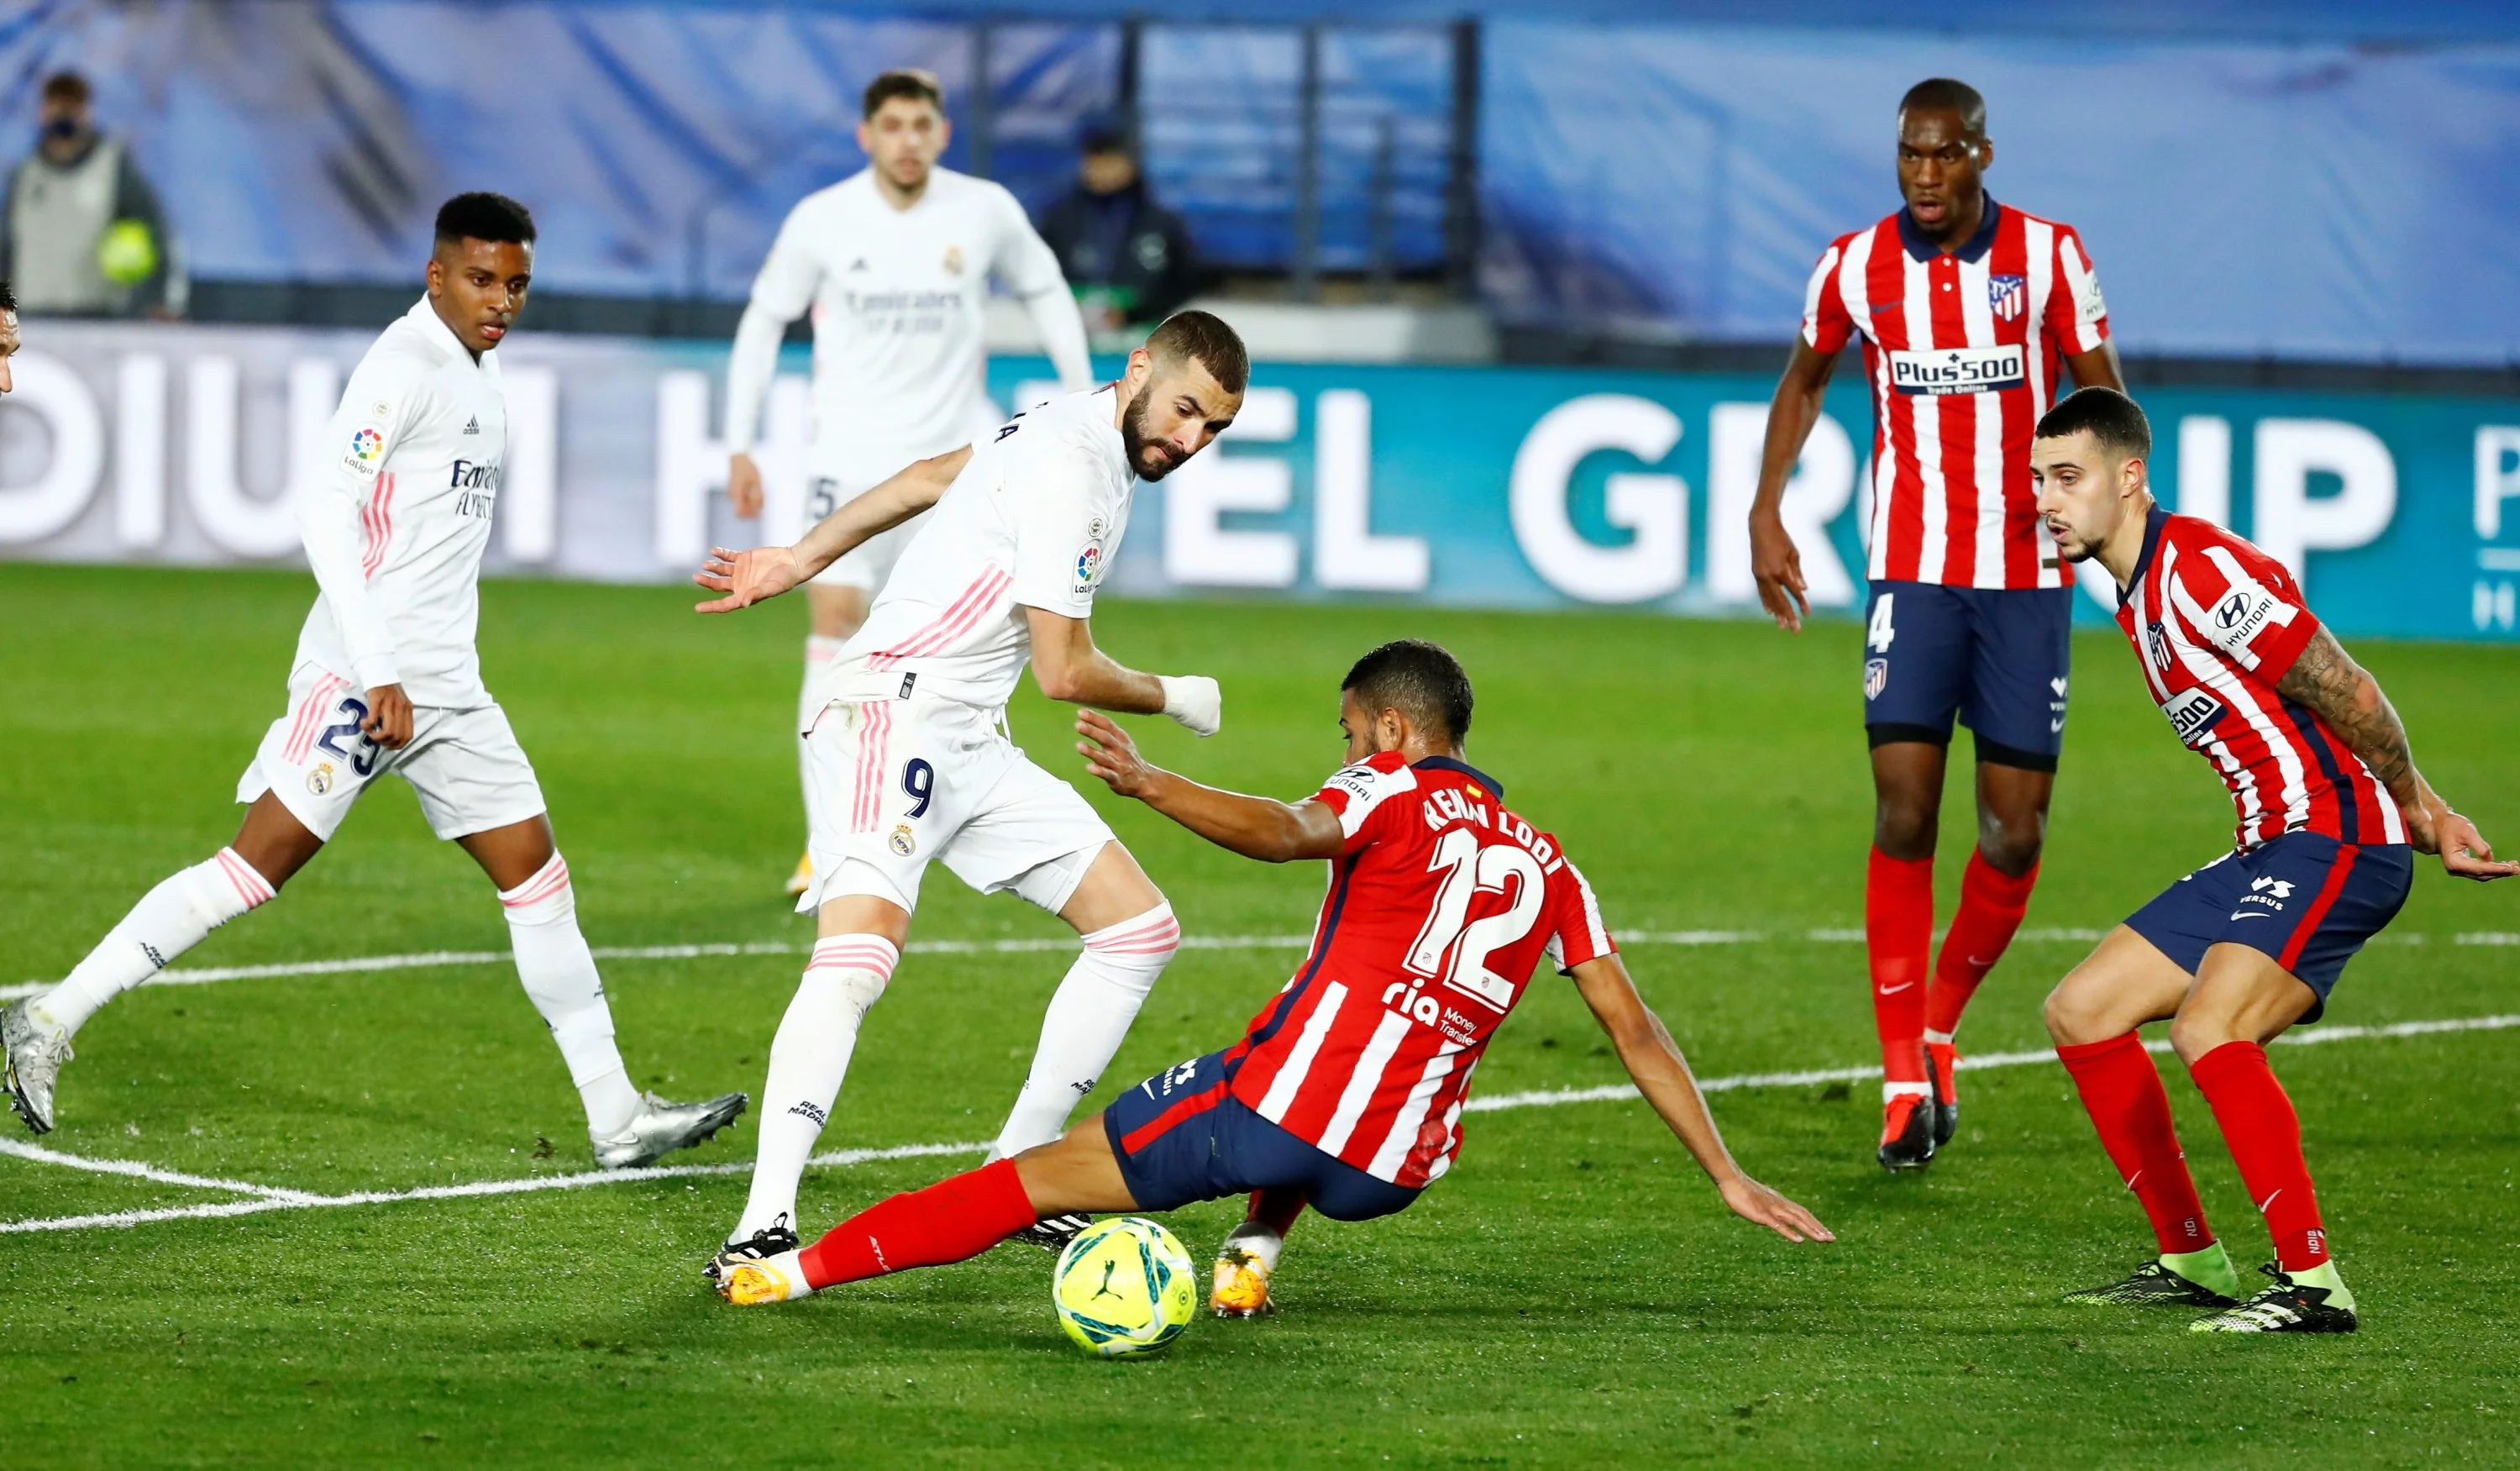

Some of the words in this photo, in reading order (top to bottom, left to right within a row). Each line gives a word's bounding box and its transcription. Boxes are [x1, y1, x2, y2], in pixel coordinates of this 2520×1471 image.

[1895, 357, 2019, 382] Plus500
[1927, 385, 1950, 395] Trade
[1955, 384, 1988, 394] Online
[344, 455, 374, 475] LaLiga
[1509, 393, 2399, 620] GRP
[1867, 592, 1896, 654] 4
[2226, 598, 2273, 647] HYUNDAI
[900, 757, 935, 821] 9
[1497, 812, 1563, 876] LODI
[1402, 827, 1546, 1016] 12
[1380, 977, 1440, 1027] ria
[1444, 1006, 1478, 1035] Money
[800, 1101, 826, 1120] REAL
